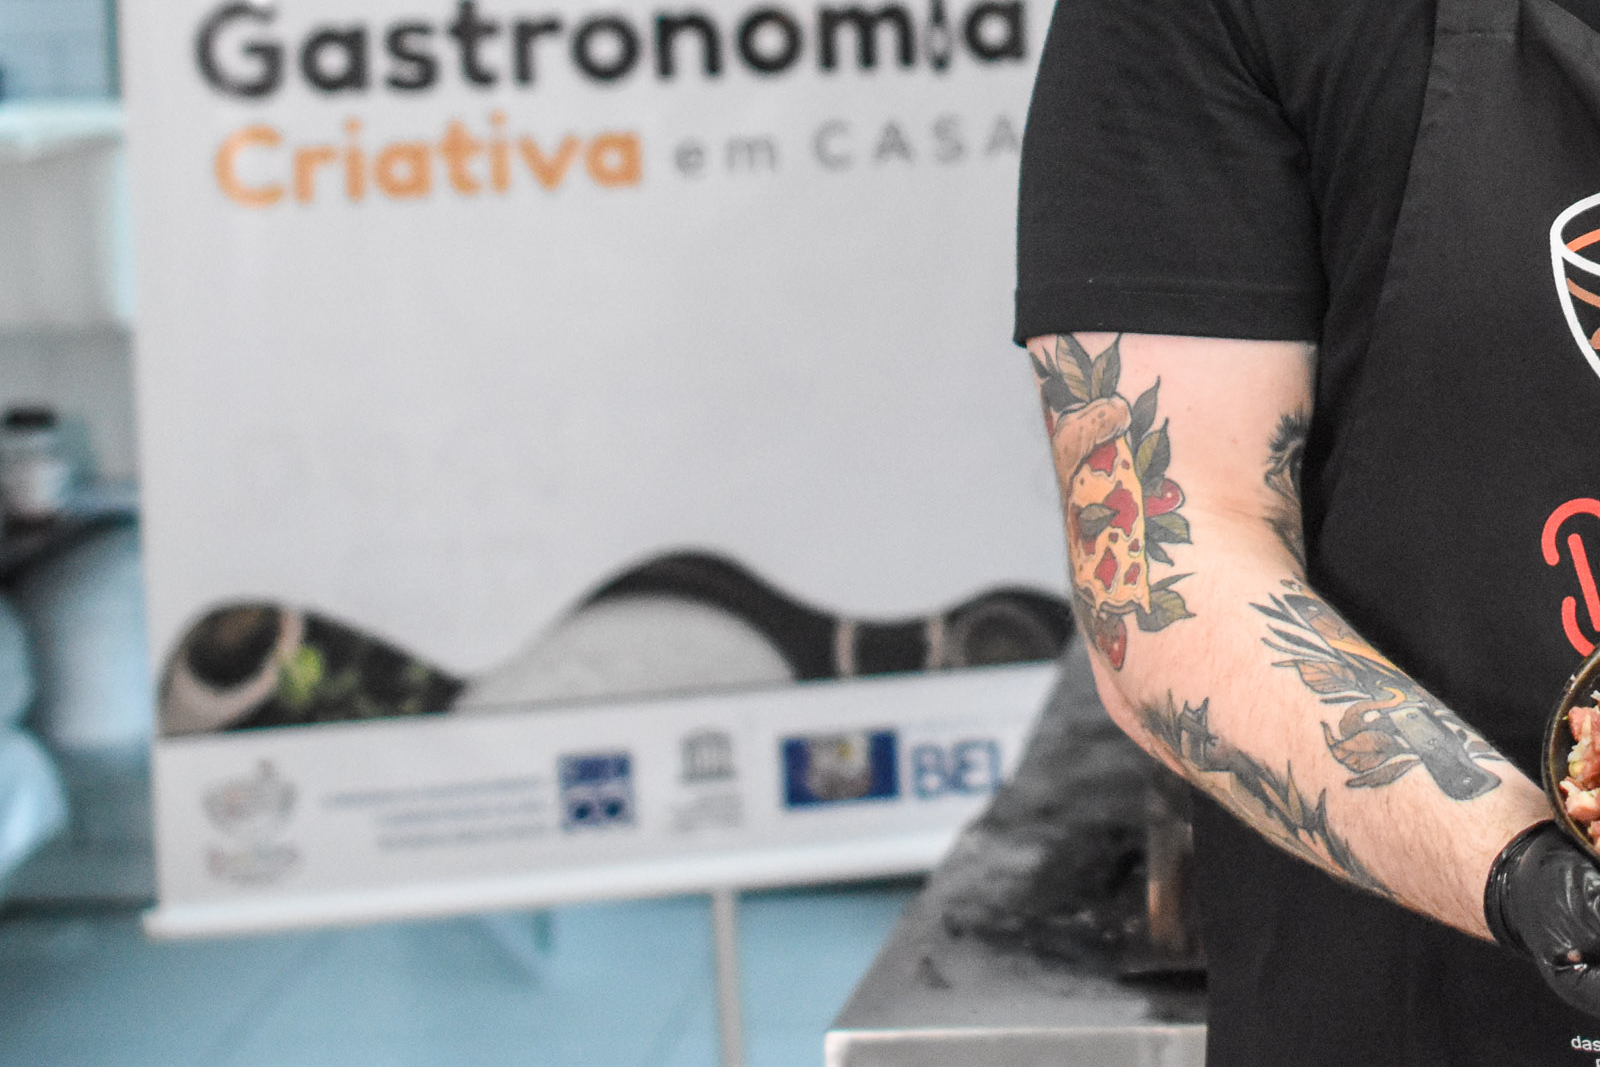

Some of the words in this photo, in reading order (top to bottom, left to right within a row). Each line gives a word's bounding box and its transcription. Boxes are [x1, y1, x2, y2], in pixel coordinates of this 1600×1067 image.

[214, 108, 644, 208] Criativa
[673, 134, 779, 178] em
[811, 113, 1023, 174] CASA
